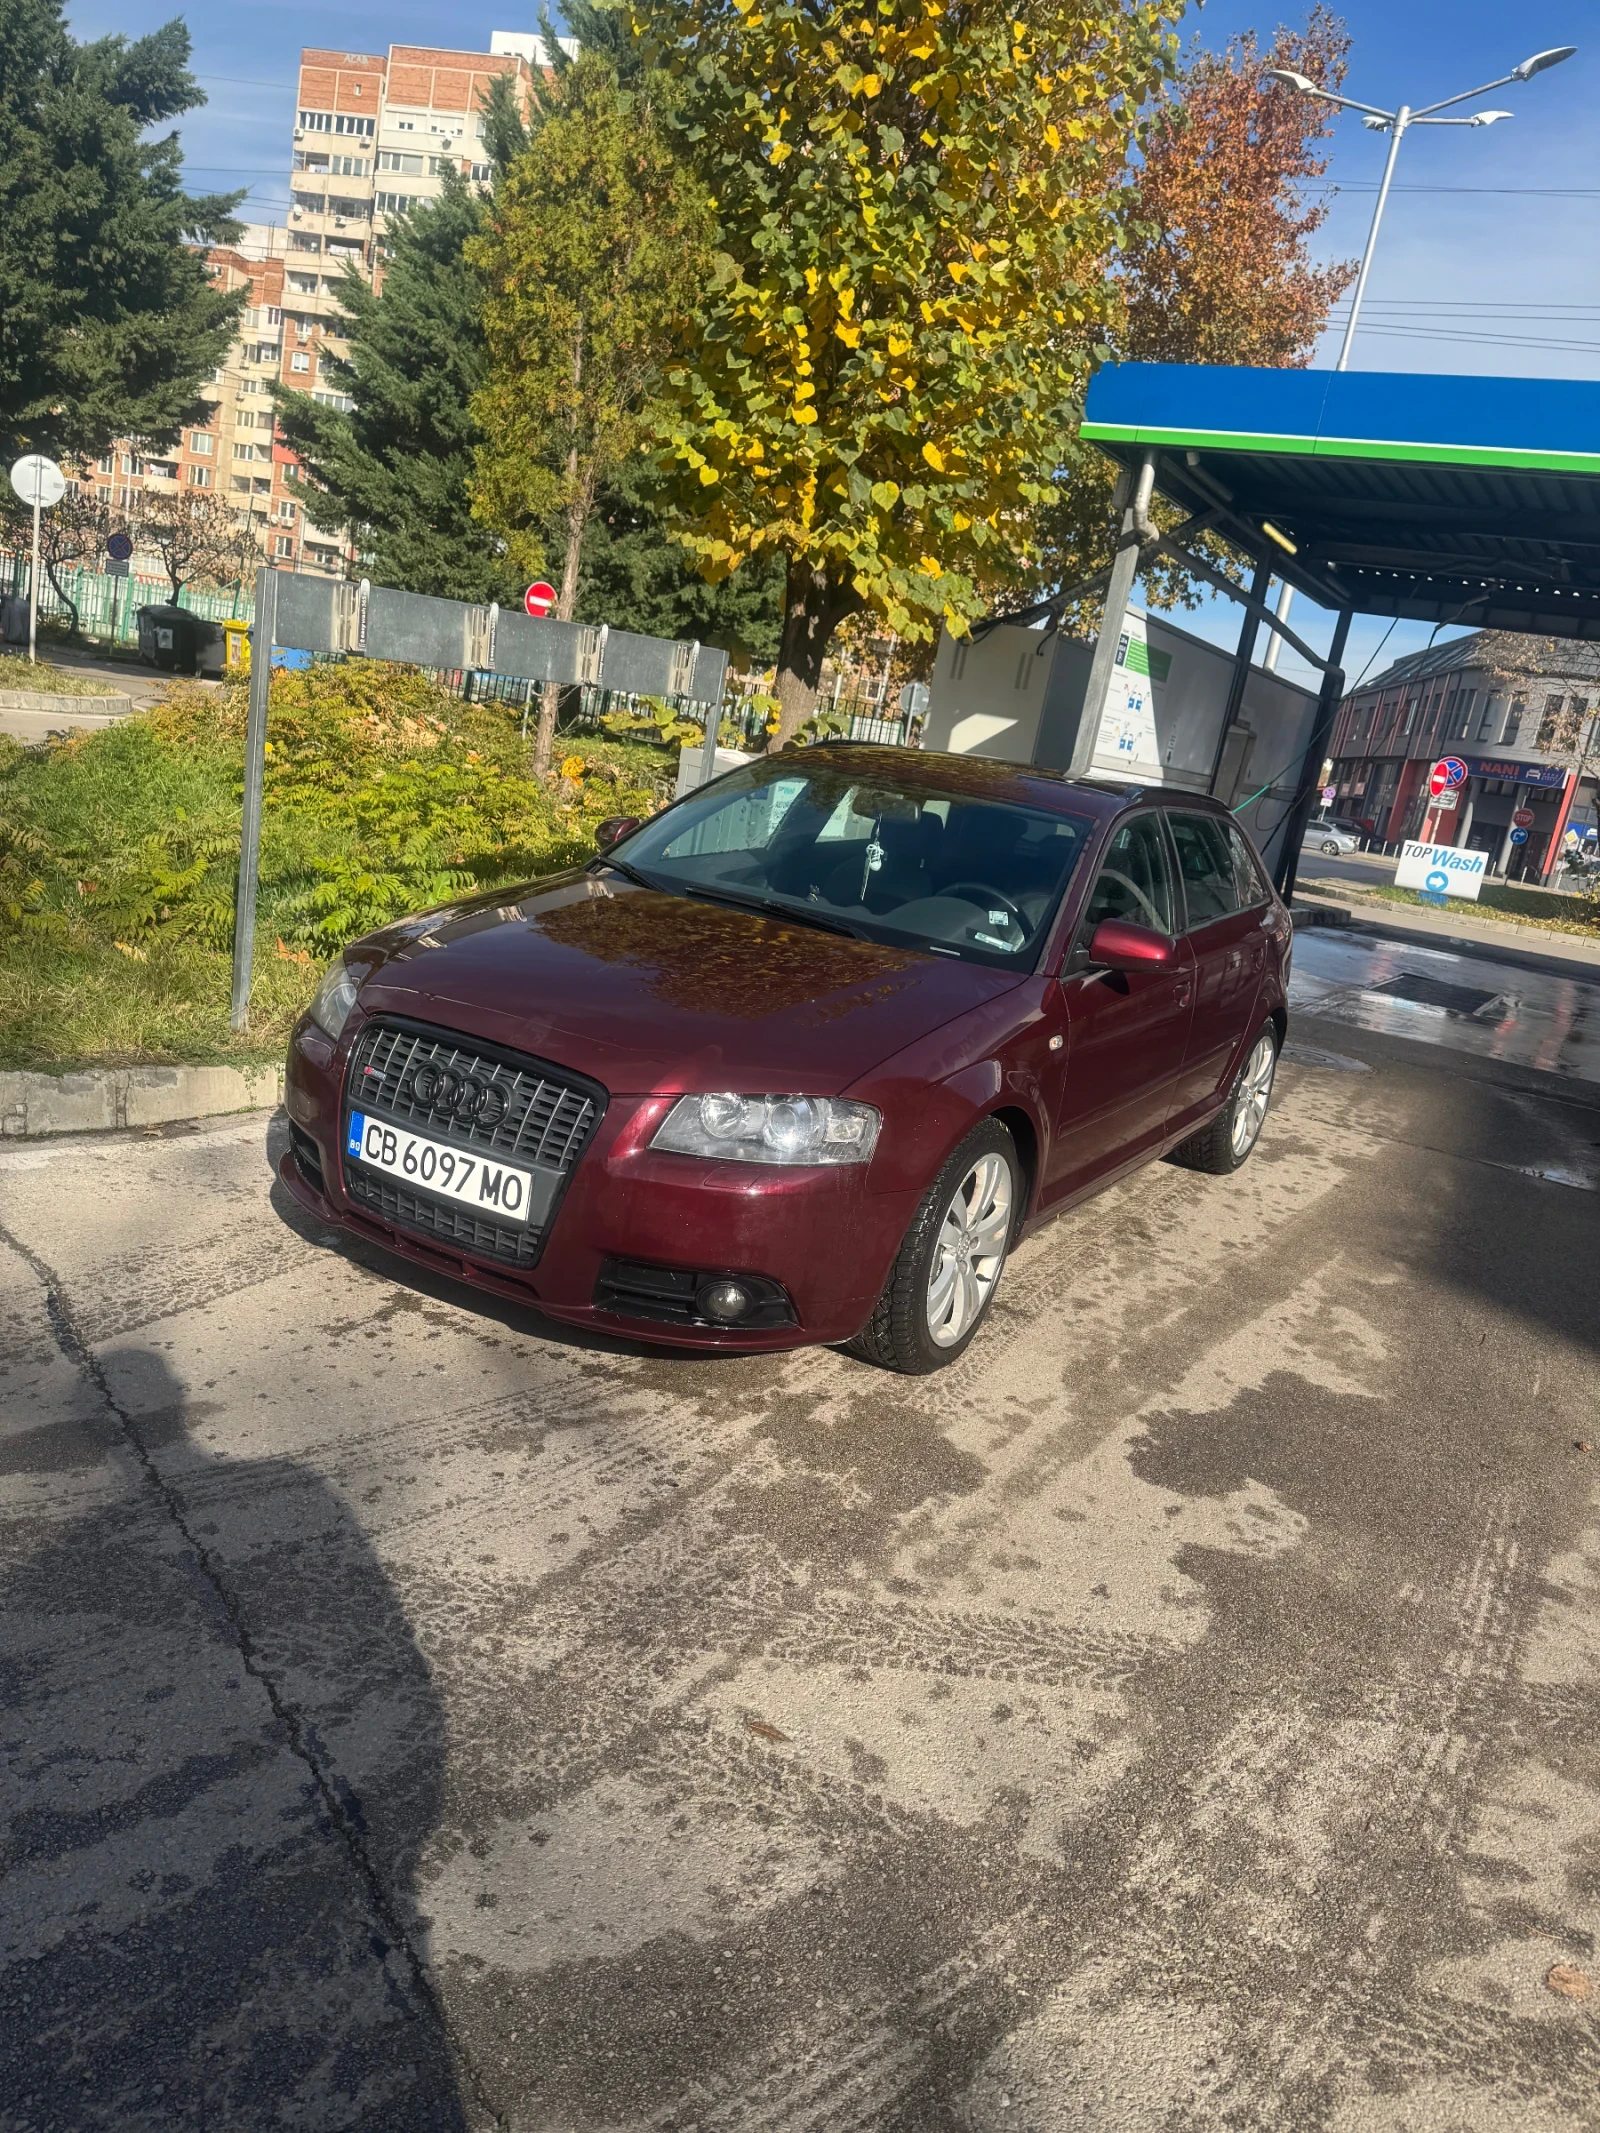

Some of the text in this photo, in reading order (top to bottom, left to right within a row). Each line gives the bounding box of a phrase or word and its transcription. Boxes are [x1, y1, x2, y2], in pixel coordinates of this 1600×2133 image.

[1480, 761, 1520, 776] NANI
[1515, 813, 1532, 823] STOP
[365, 1124, 523, 1211] CB 6097 MO
